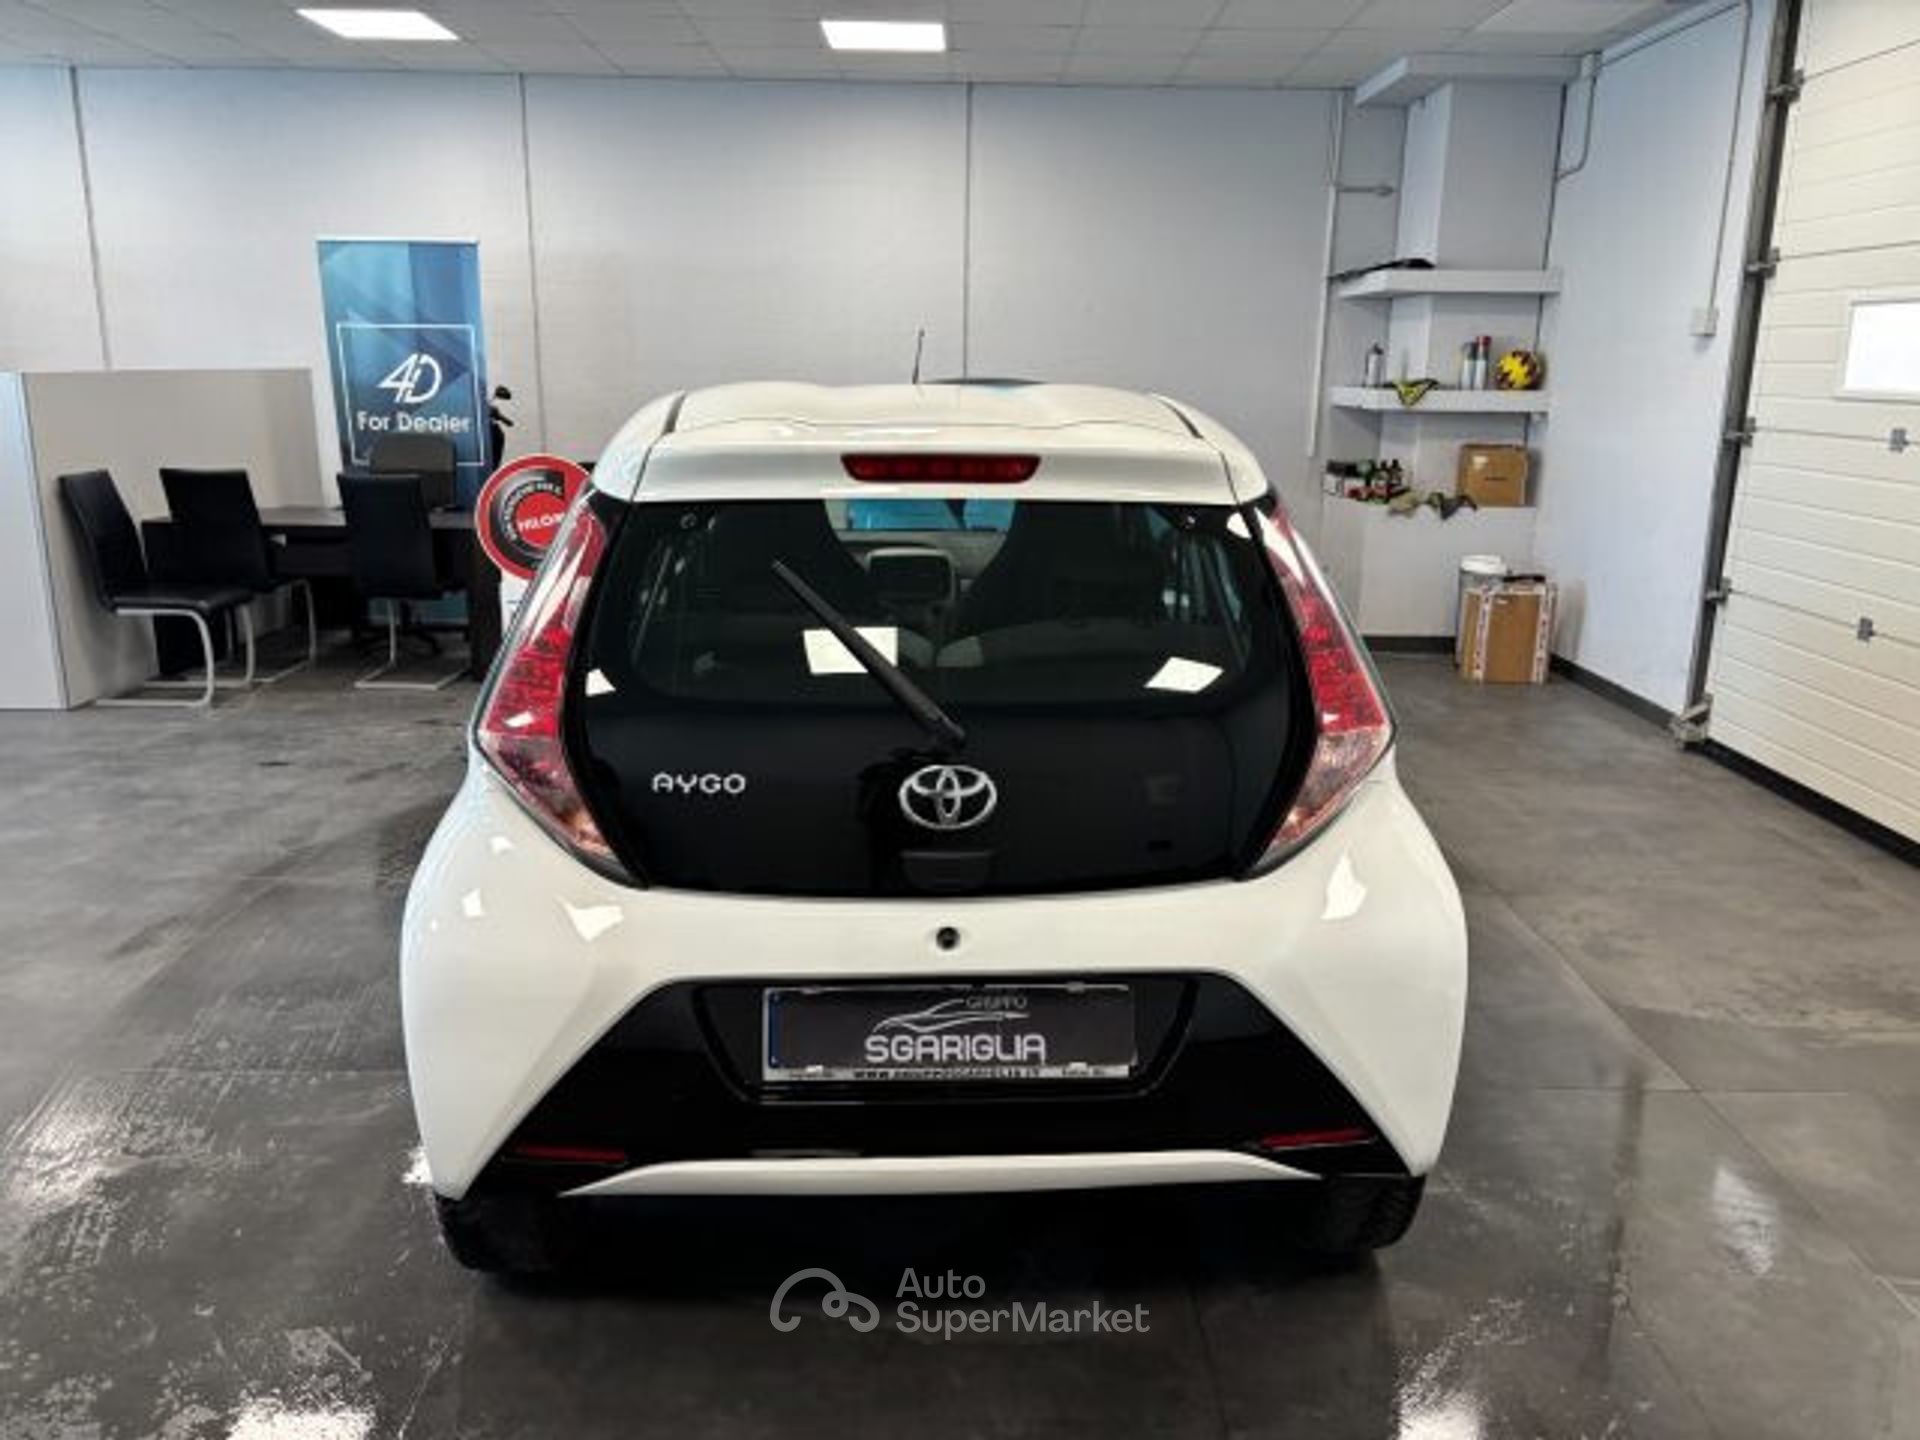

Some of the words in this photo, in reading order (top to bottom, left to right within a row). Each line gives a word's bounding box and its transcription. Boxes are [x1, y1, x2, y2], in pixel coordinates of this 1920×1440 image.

[357, 410, 391, 431] For
[396, 411, 472, 433] Dealer
[652, 772, 746, 793] AYGO
[864, 1033, 1047, 1063] SGARIGLIA
